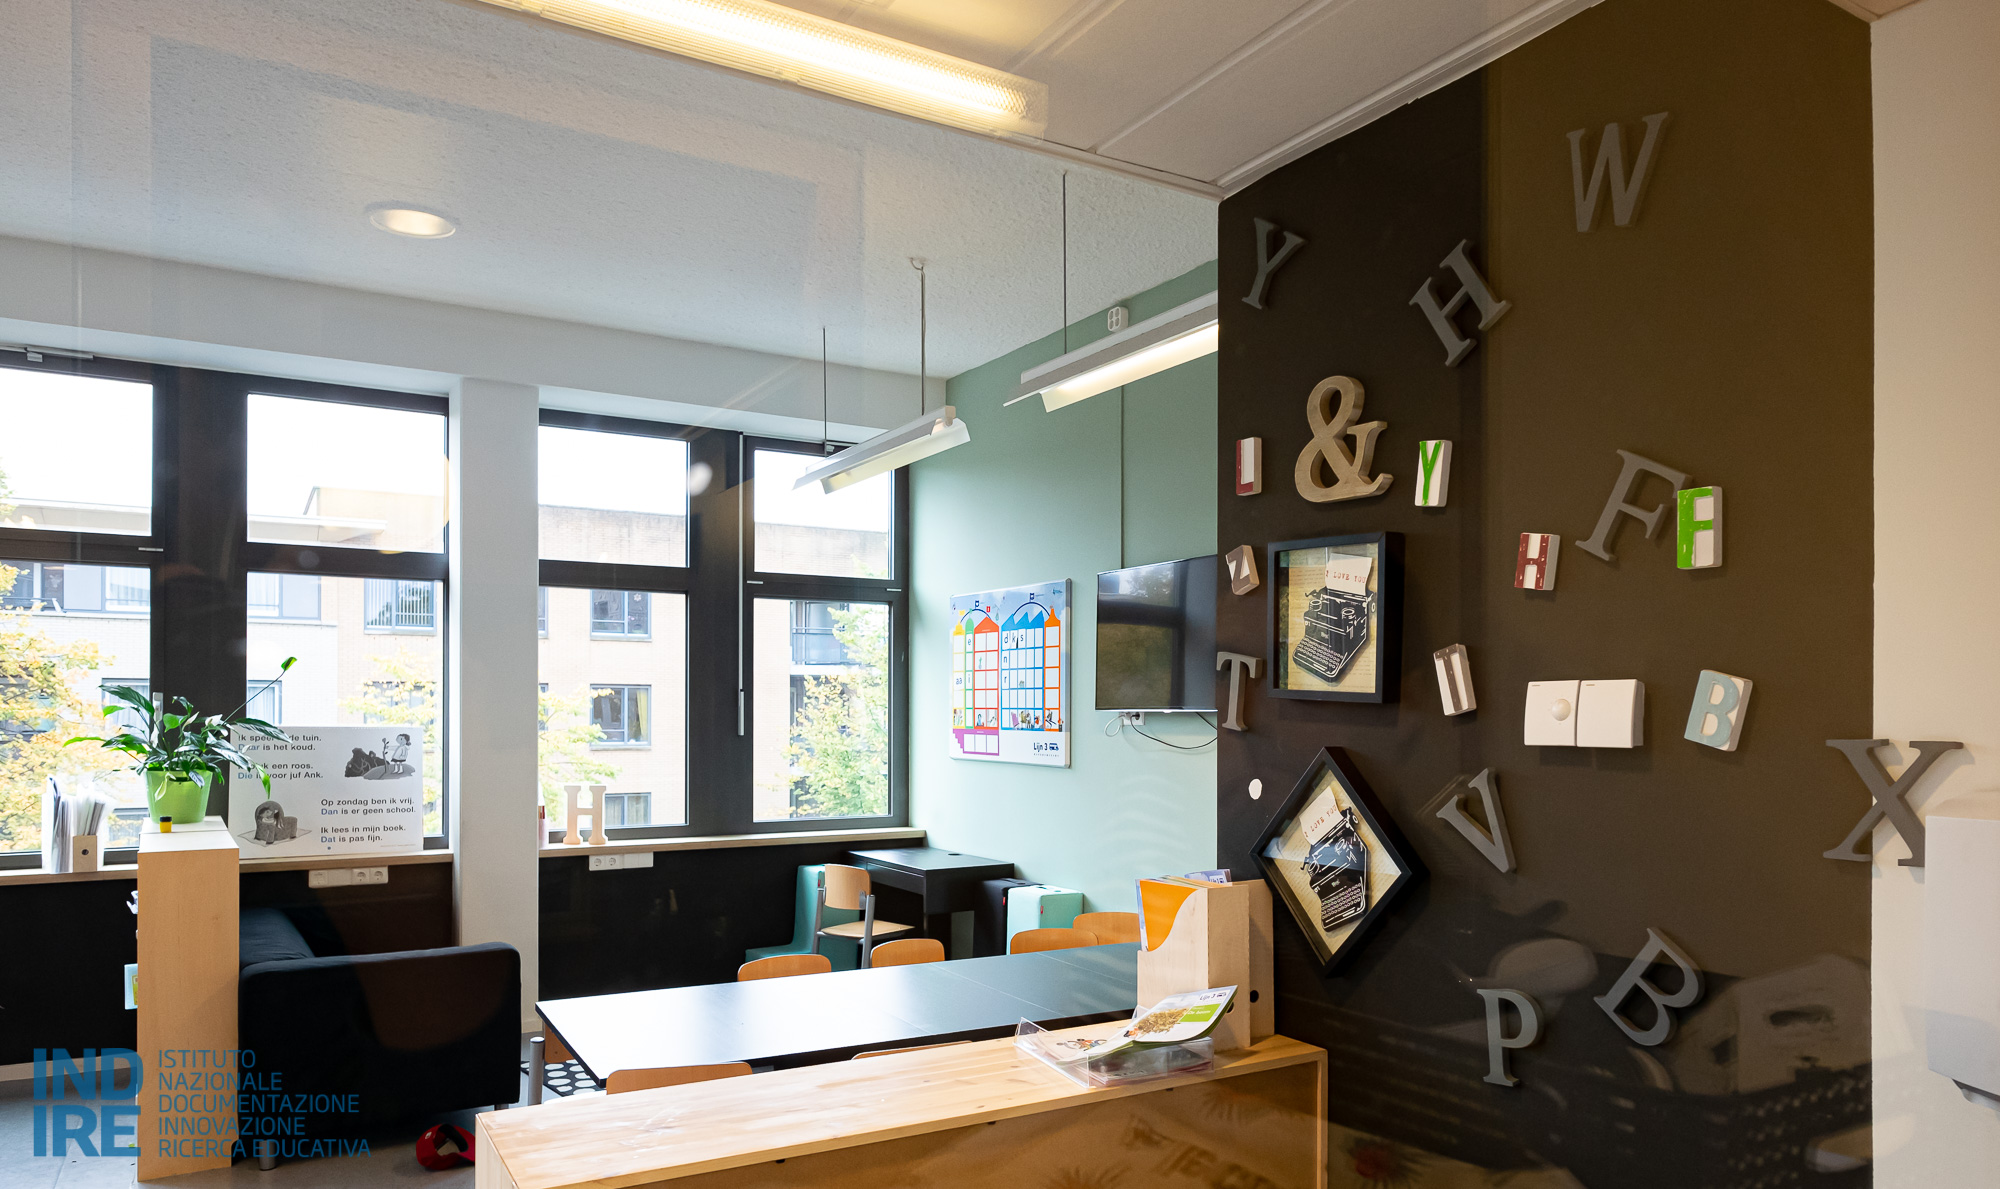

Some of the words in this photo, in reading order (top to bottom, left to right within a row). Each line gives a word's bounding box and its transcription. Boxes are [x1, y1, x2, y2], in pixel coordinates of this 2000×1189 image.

[1566, 111, 1668, 232] W
[1242, 217, 1306, 310] Y
[1409, 238, 1512, 367] H
[1295, 375, 1394, 502] &
[1418, 440, 1443, 506] Y
[1574, 449, 1692, 561] F
[1225, 545, 1254, 595] Z
[1325, 570, 1329, 578] I
[1333, 571, 1350, 581] LOVE
[1354, 575, 1367, 584] YOU
[1514, 532, 1552, 591] H
[967, 638, 972, 646] e
[1003, 633, 1009, 644] d
[955, 677, 963, 685] aa
[1216, 651, 1263, 731] T
[1684, 669, 1743, 749] B
[273, 743, 288, 751] het
[291, 743, 316, 751] koud.
[302, 734, 322, 742] tuin.
[1033, 742, 1043, 752] Lijn
[1044, 742, 1048, 750] 3
[237, 772, 253, 780] Die
[289, 771, 301, 780] juf
[303, 771, 323, 779] Ank.
[320, 799, 334, 807] Op
[337, 798, 369, 807] zondag
[400, 797, 415, 805] vrij.
[1823, 738, 1963, 866] X
[362, 825, 381, 834] mijn
[367, 834, 383, 843] fijn.
[563, 785, 607, 845] H
[1310, 816, 1325, 832] LOVE
[1326, 804, 1337, 817] YOU
[1436, 768, 1516, 873] V
[1594, 927, 1705, 1047] B
[1476, 988, 1543, 1087] P
